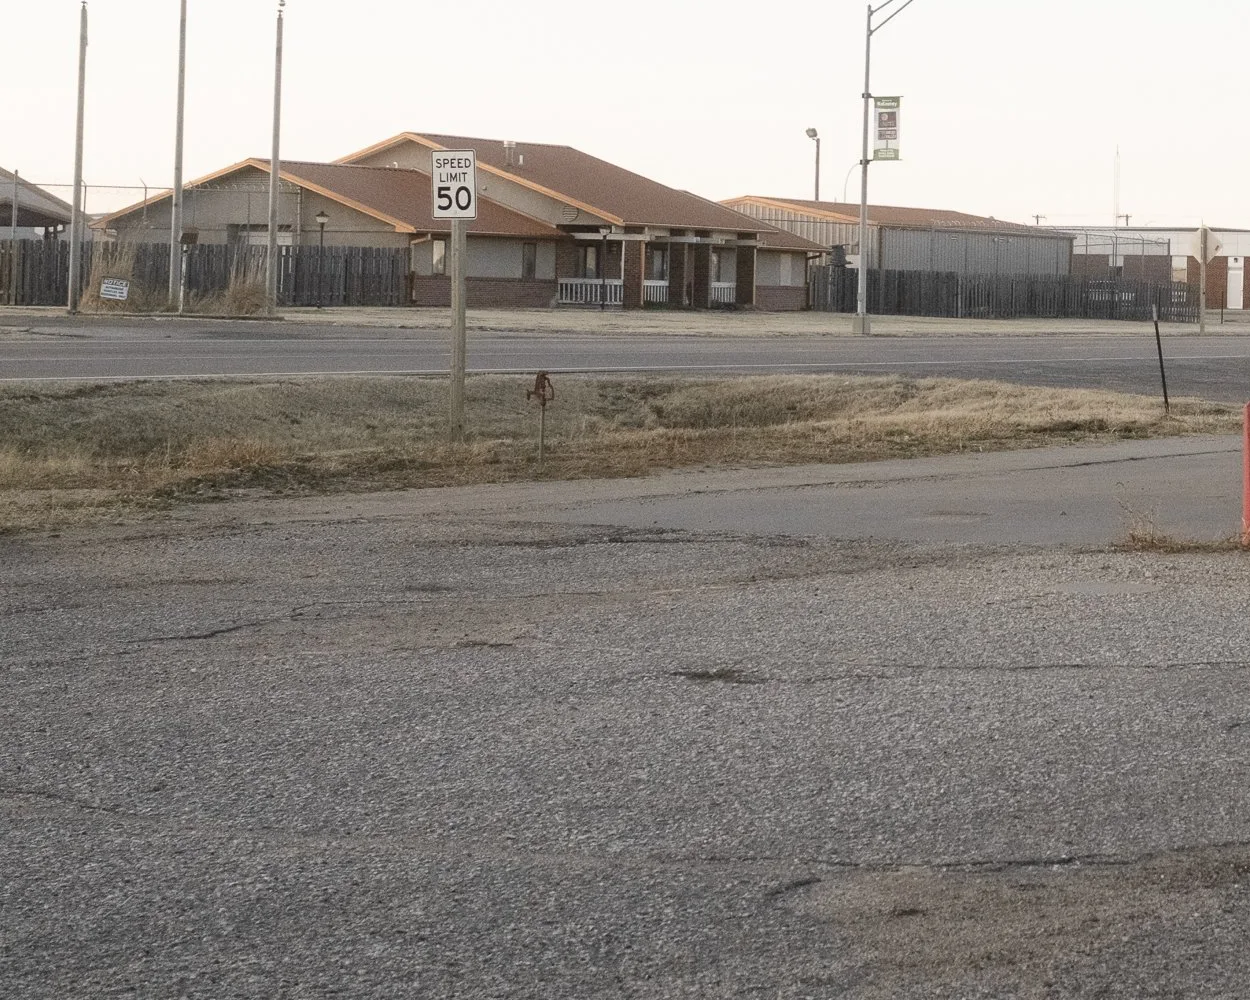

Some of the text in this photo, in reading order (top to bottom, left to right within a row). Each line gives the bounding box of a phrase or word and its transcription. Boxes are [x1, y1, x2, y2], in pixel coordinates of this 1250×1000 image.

[435, 158, 471, 168] SPEED
[439, 172, 468, 182] LIMIT
[437, 186, 471, 210] 50
